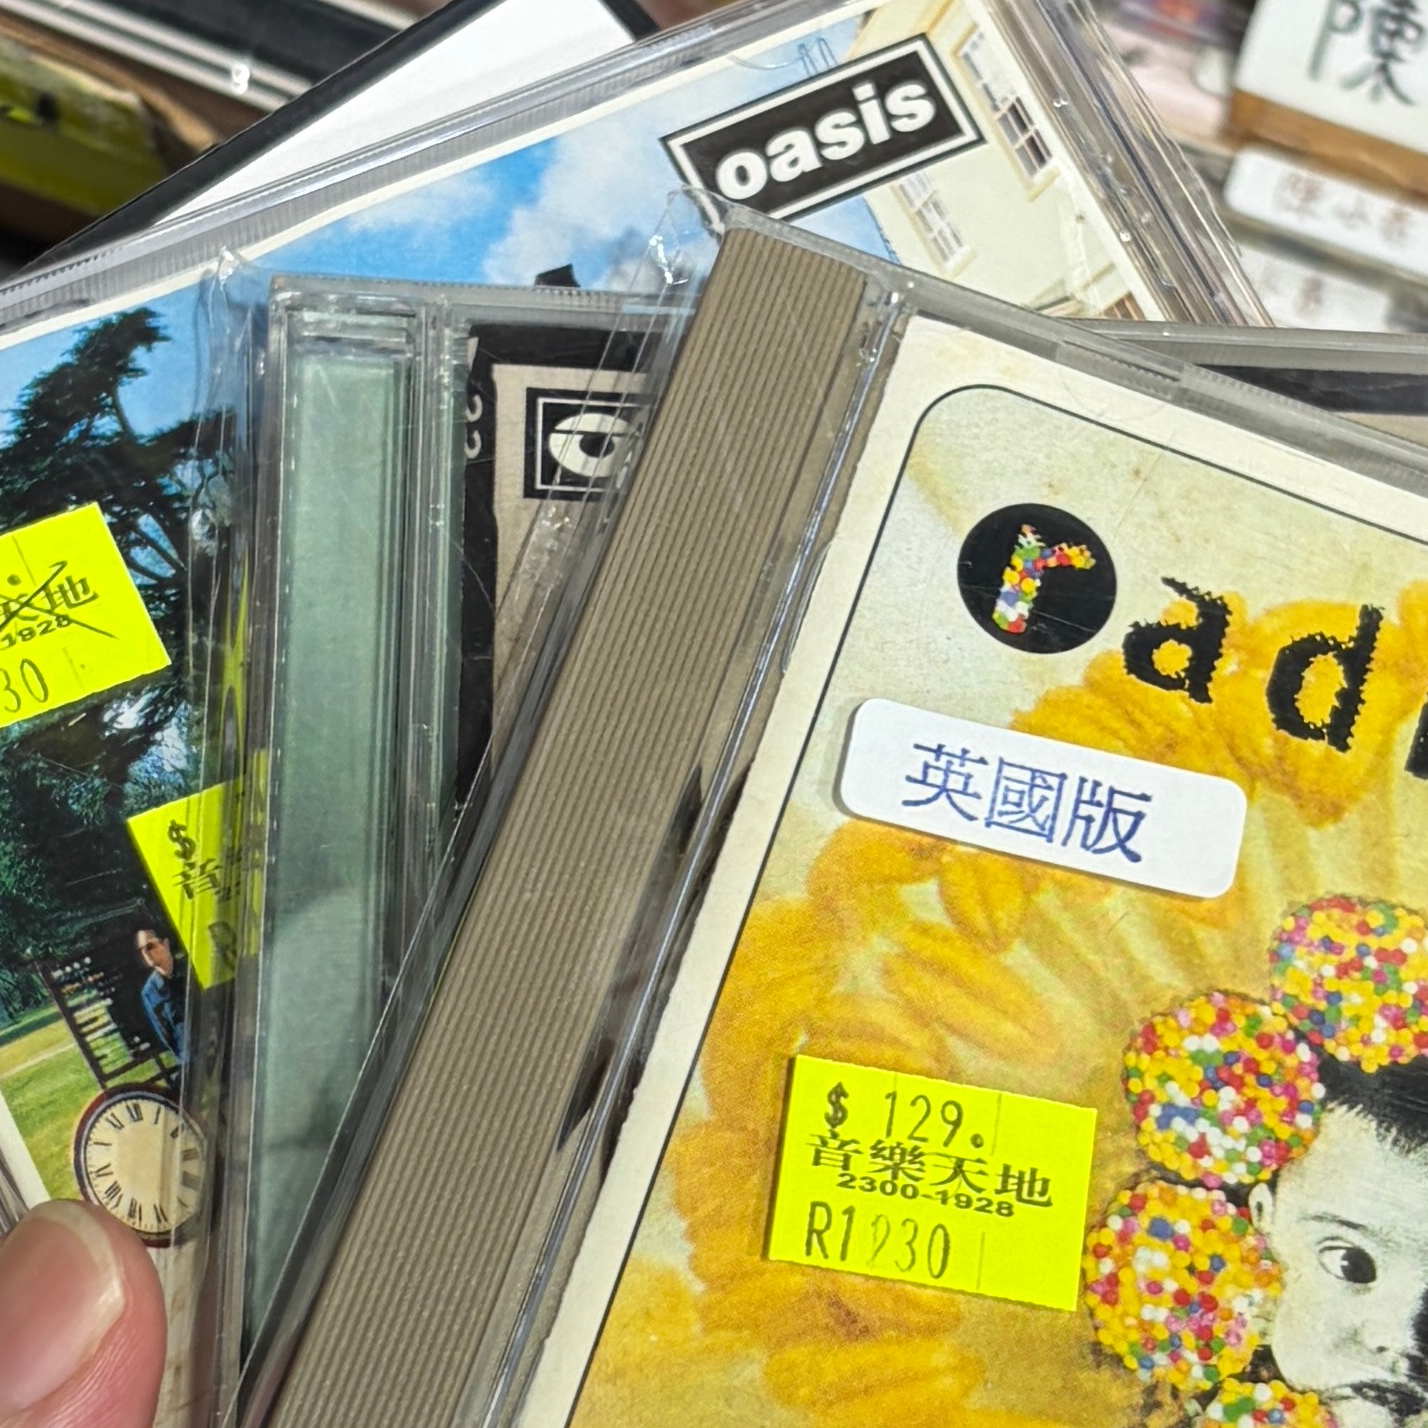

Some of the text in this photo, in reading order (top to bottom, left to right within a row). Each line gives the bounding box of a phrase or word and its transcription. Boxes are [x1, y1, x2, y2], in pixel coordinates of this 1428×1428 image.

[715, 75, 941, 203] oasis
[900, 740, 1154, 865] 英國版
[824, 1081, 850, 1130] $
[806, 1127, 1054, 1208] 音樂天地
[835, 1171, 1015, 1218] 2300-1928
